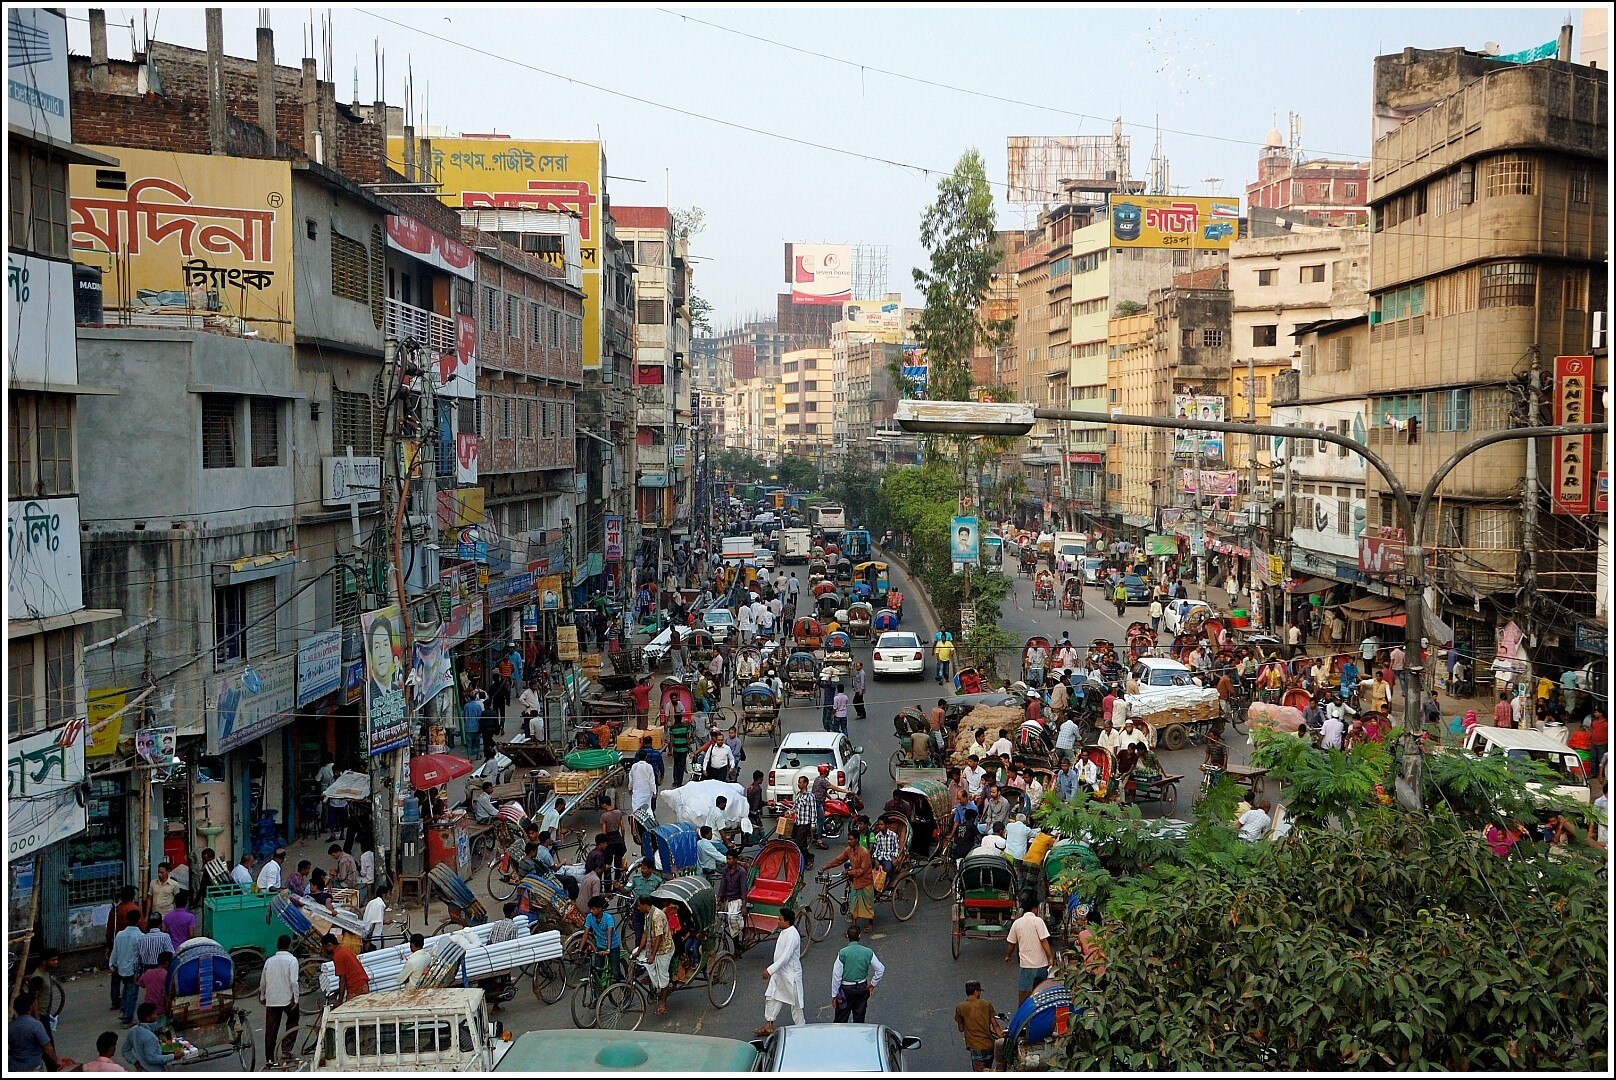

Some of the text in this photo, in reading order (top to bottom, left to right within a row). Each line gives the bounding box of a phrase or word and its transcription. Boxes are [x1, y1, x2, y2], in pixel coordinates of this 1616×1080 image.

[40, 93, 60, 115] build
[538, 154, 569, 172] সেরা
[71, 177, 276, 263] মদিনা
[1147, 203, 1198, 233] গাজী
[1561, 493, 1582, 501] FASHION
[23, 502, 60, 553] লিঃ
